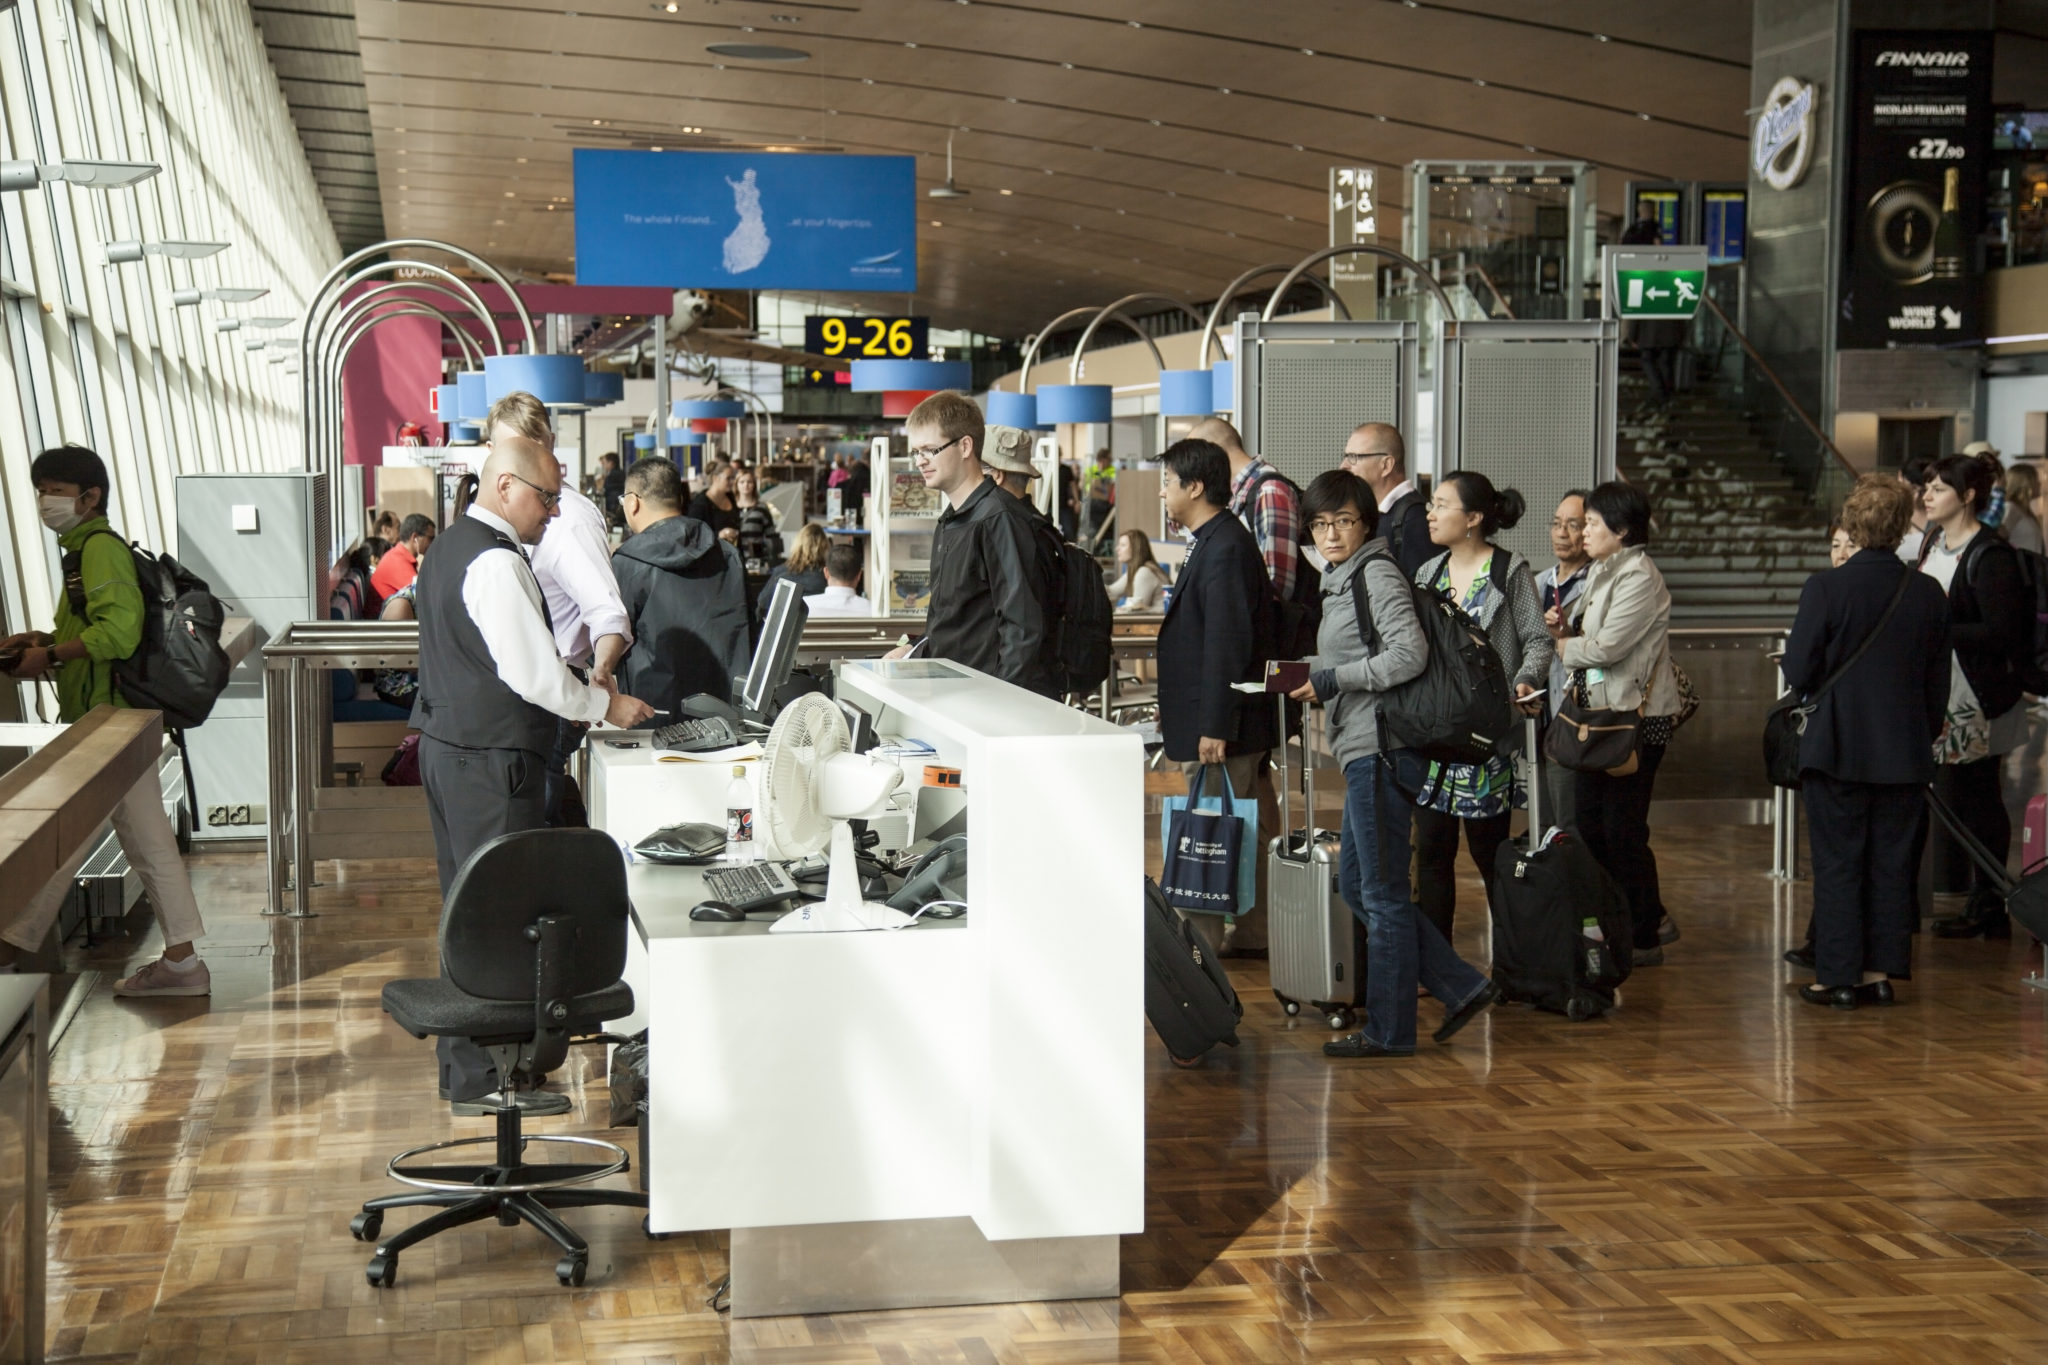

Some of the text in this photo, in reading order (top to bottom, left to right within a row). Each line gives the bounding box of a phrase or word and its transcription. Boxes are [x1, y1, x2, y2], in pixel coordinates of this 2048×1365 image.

[1875, 51, 1969, 66] FINNAIR
[1949, 67, 1969, 78] SHOP
[1874, 104, 1967, 116] NICOLAS FEUILLATTE
[624, 213, 643, 225] The
[644, 213, 672, 225] whole
[804, 218, 825, 229] your
[1902, 305, 1937, 316] WINE
[1888, 316, 1937, 329] WORLD
[821, 318, 914, 357] 9-26
